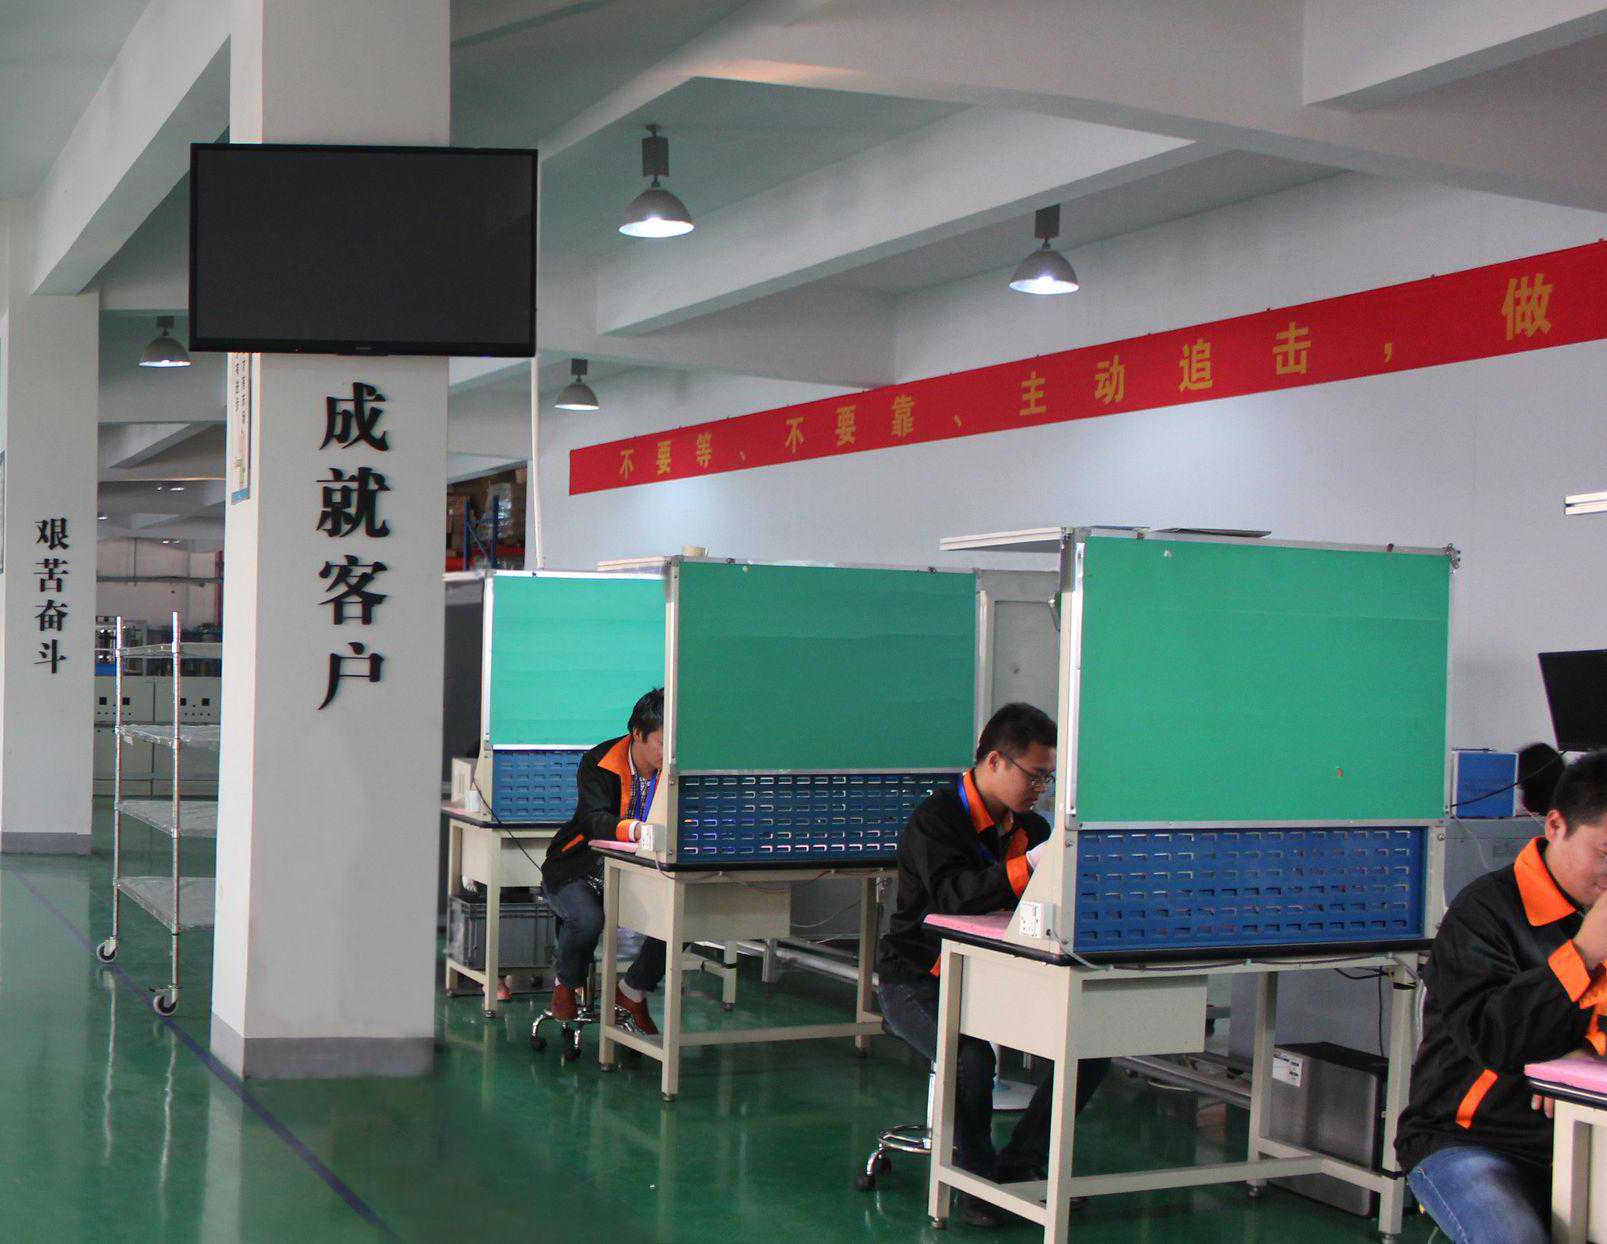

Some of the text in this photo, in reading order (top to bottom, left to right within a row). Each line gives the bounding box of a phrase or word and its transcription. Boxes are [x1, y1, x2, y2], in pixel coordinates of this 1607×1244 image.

[33, 517, 70, 675] 艰苦奋斗
[315, 381, 391, 711] 成就客户
